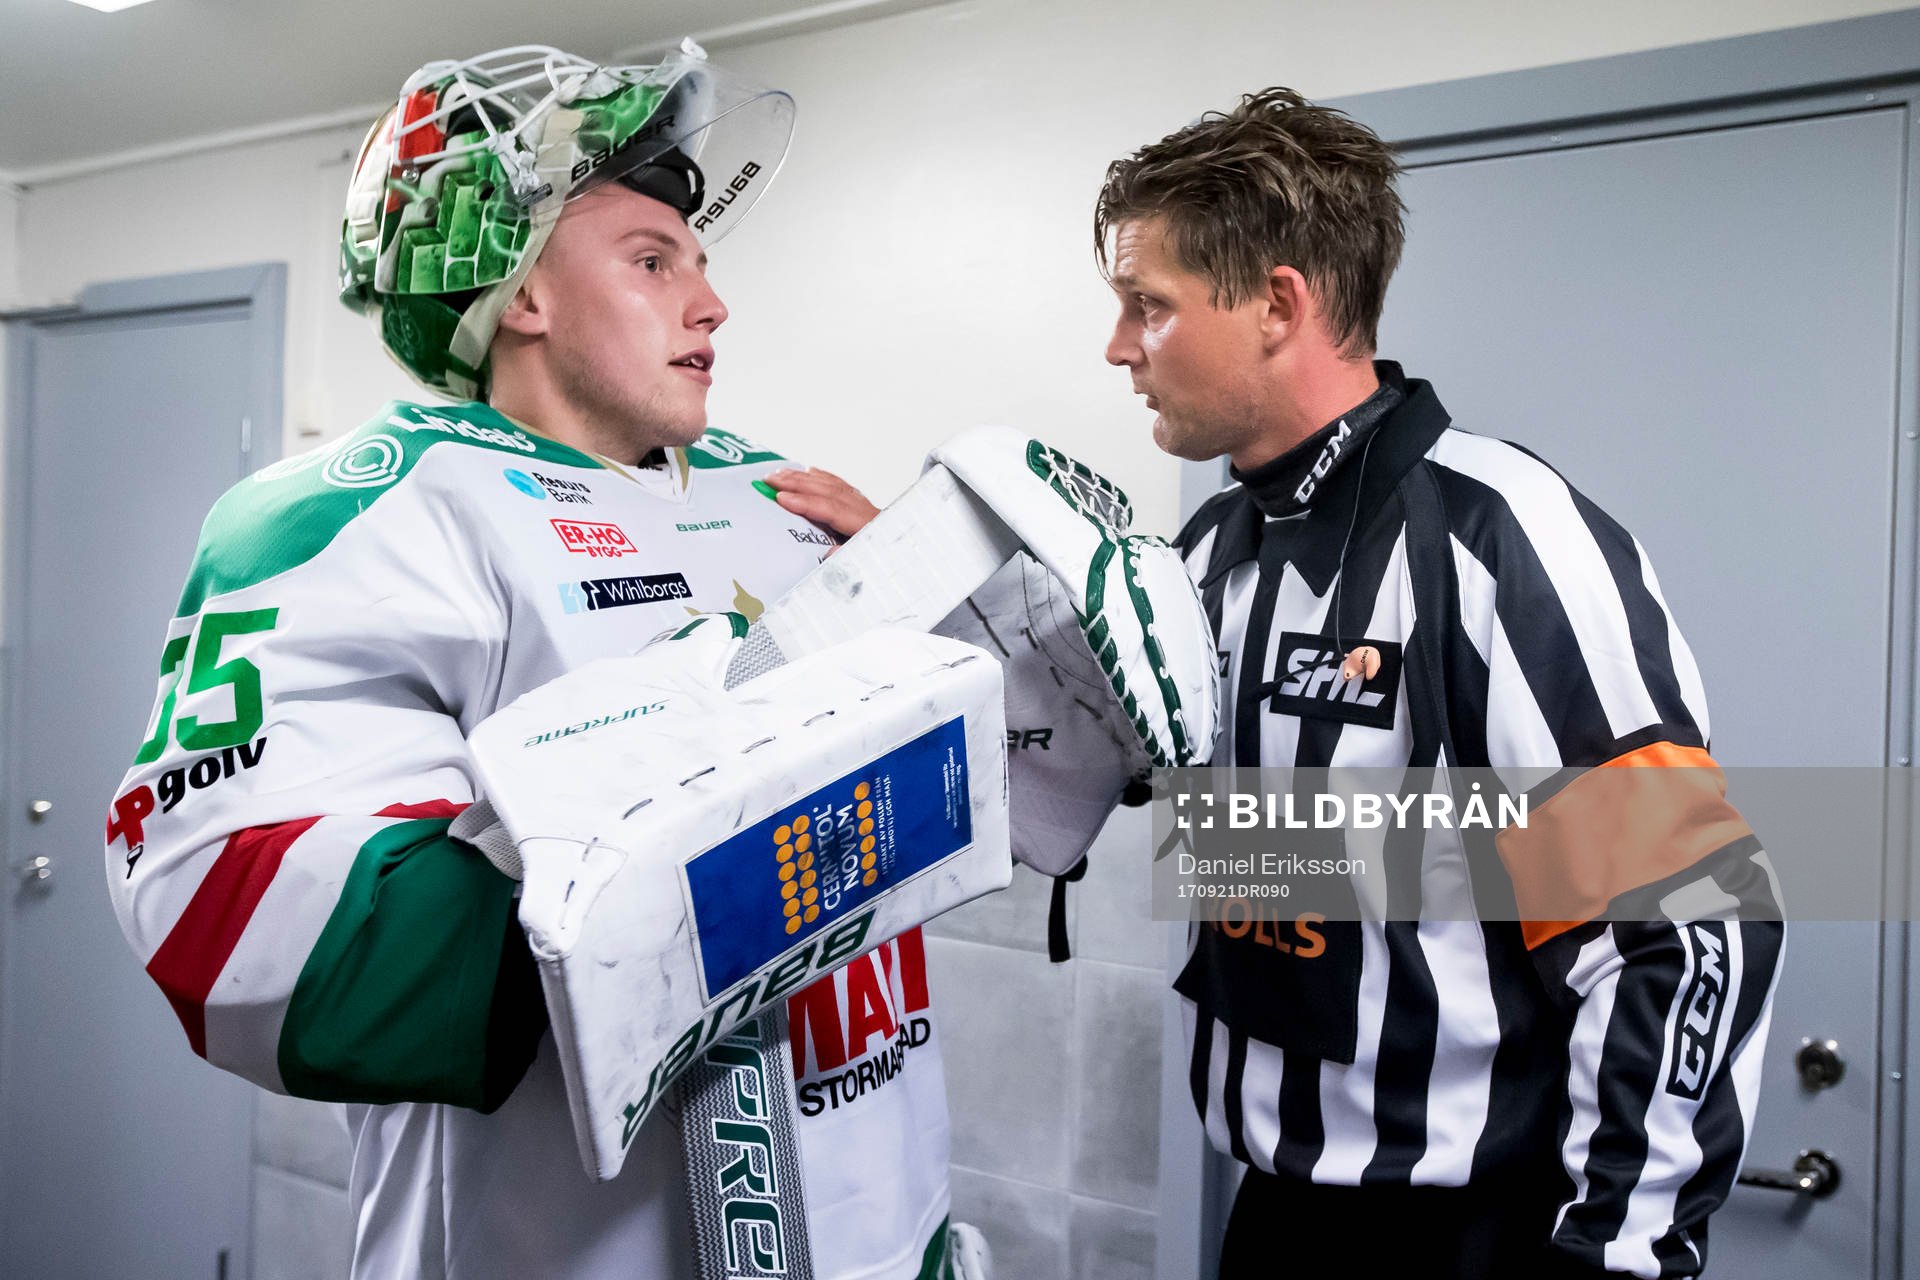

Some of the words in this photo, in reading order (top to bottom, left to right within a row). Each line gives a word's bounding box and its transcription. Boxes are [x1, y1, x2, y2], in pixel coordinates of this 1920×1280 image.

[385, 407, 537, 453] Lindab
[532, 472, 592, 494] Resurs
[1294, 419, 1352, 503] CCM
[548, 488, 593, 505] Bank
[558, 524, 626, 546] ER-HO
[585, 545, 623, 558] BYGG
[602, 577, 688, 600] Wihlborgs
[1279, 648, 1386, 708] SHL
[157, 737, 268, 814] golv
[836, 803, 860, 893] NOVUM
[1674, 925, 1725, 1092] CCM
